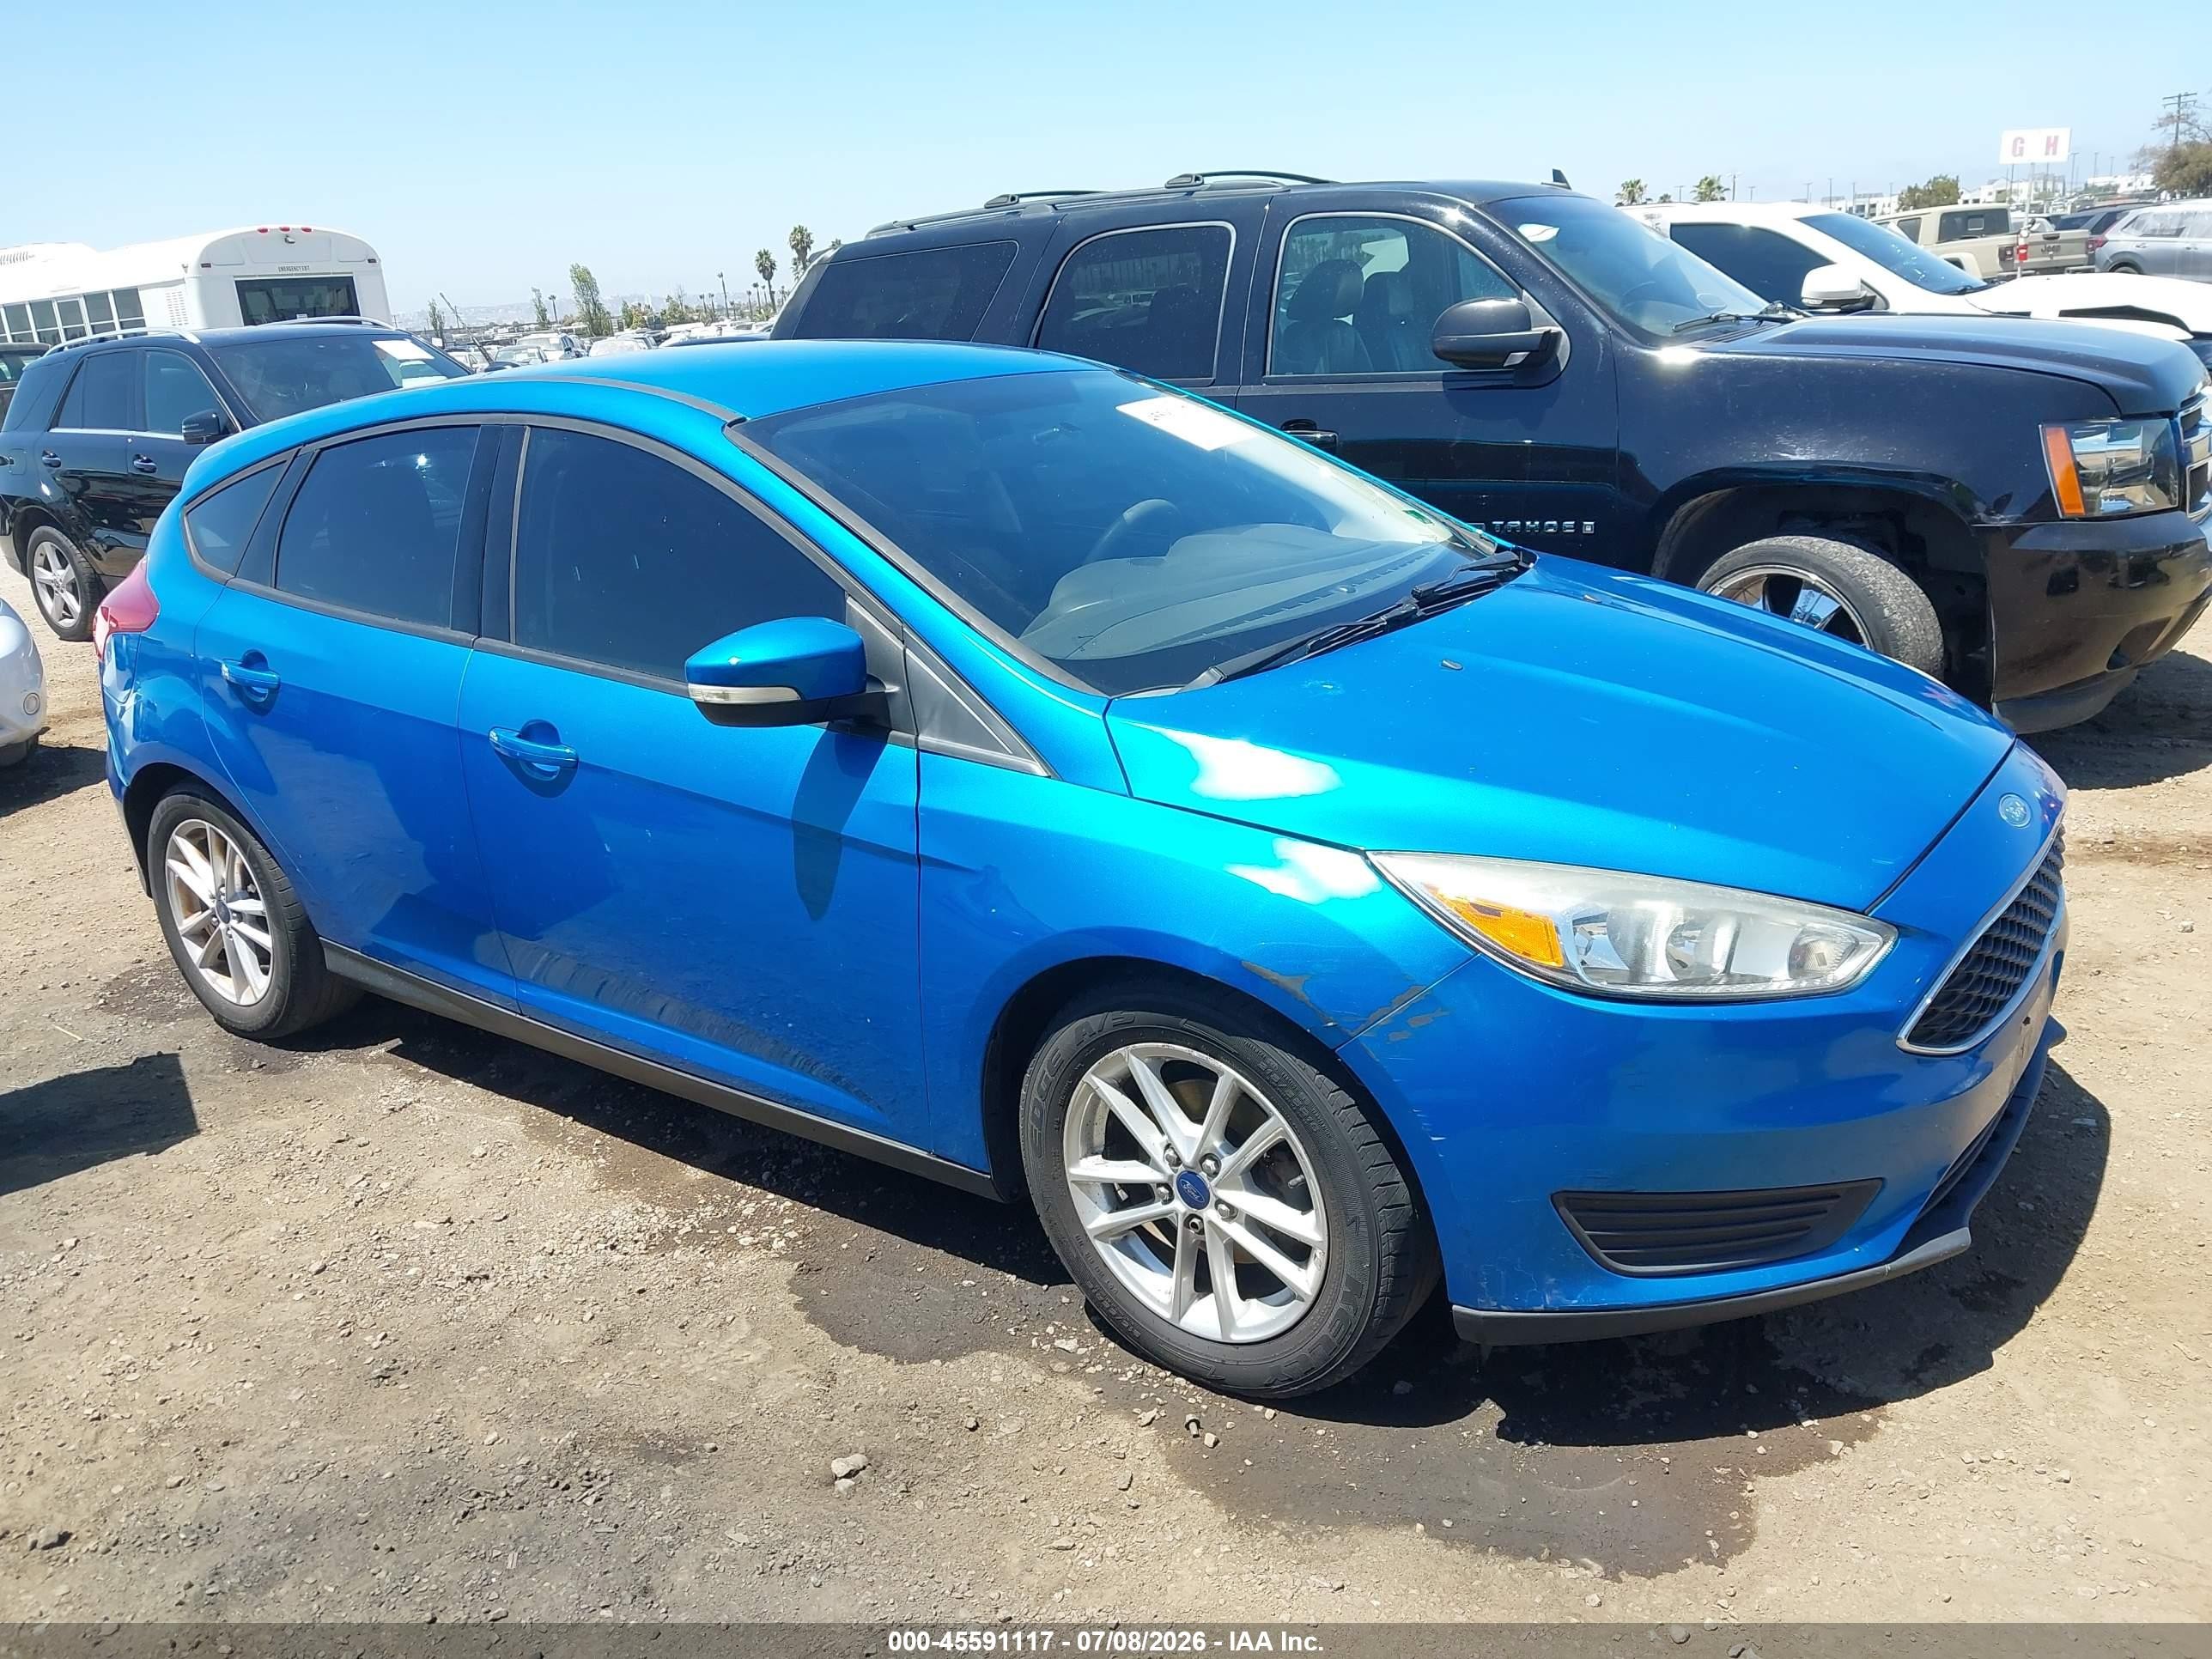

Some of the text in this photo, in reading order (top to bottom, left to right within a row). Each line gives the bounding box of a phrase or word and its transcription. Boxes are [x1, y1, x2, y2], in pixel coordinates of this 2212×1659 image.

[2011, 135, 2060, 157] G H
[2040, 244, 2061, 253] Jeep
[1492, 520, 1575, 532] TAHOE
[1030, 1044, 1065, 1159] EDGE
[1182, 1182, 1202, 1200] Ford
[1264, 1273, 1364, 1387] KELLY
